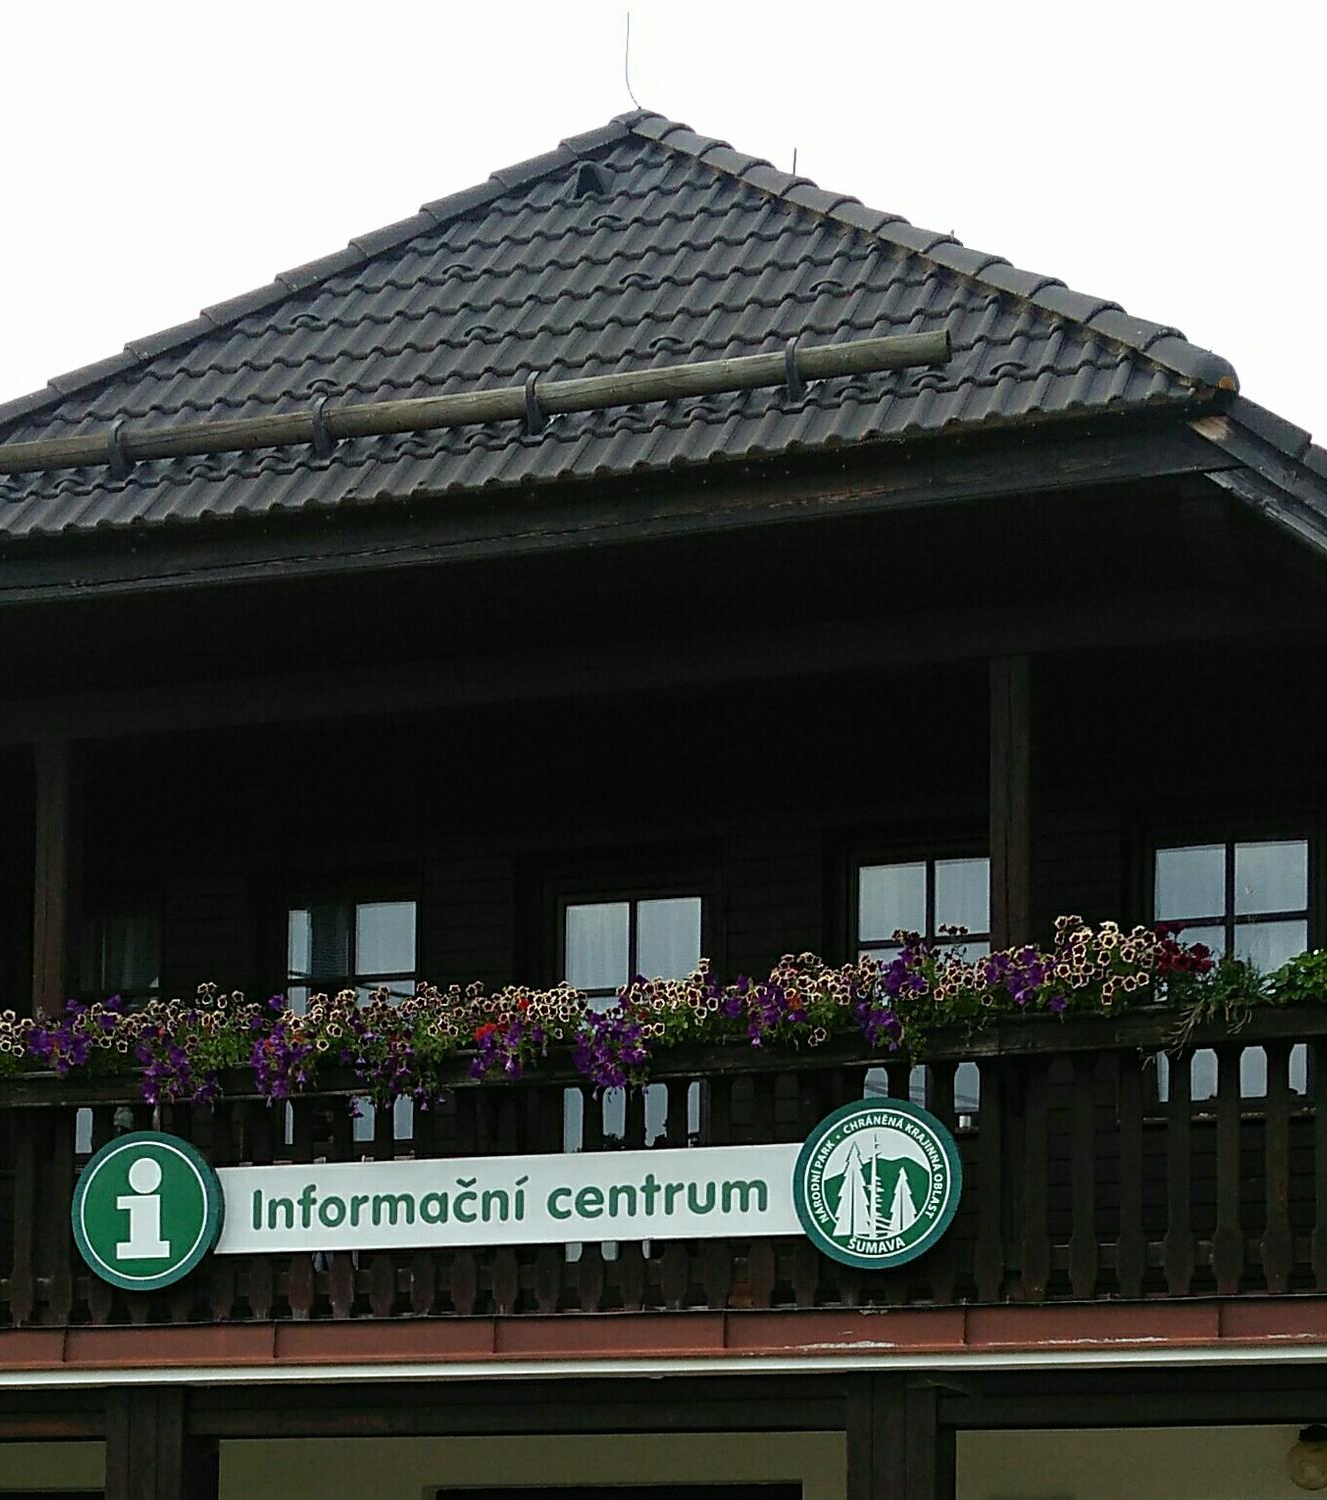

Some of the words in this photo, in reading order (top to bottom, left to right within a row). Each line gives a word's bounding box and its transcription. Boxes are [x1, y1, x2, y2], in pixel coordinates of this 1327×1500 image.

[843, 1114, 903, 1134] CHRÁNĚNÁ
[904, 1123, 944, 1171] KRAJINNÁ
[815, 1140, 835, 1169] PARK
[252, 1174, 529, 1231] Informační
[547, 1173, 768, 1220] centrum
[811, 1169, 829, 1224] NÁRODNÍ
[925, 1173, 944, 1219] OBLAST
[847, 1235, 906, 1254] ŠUMAVA
